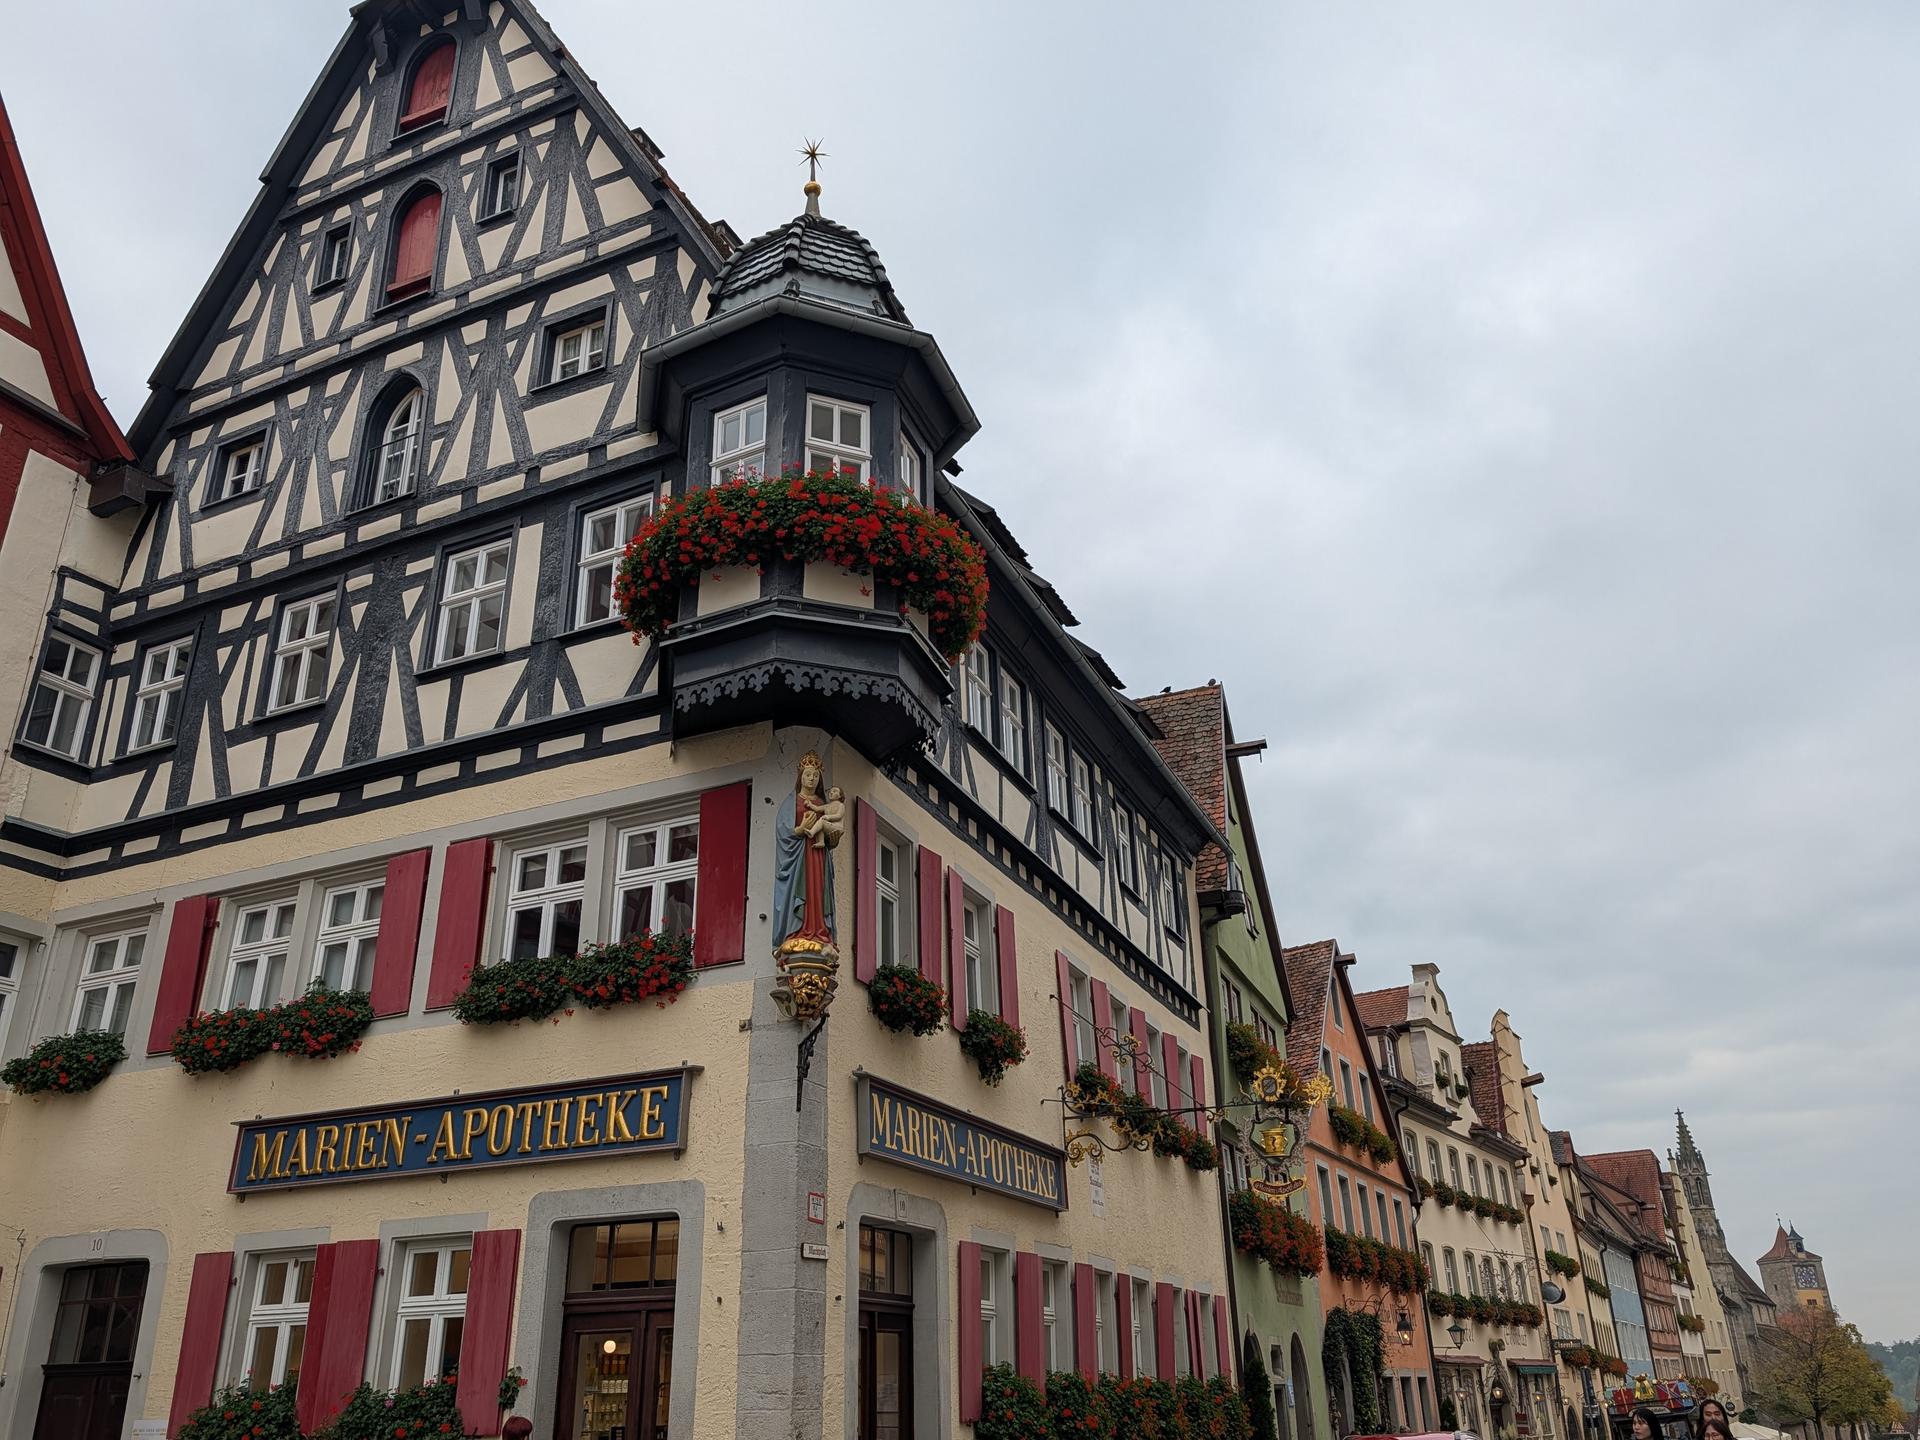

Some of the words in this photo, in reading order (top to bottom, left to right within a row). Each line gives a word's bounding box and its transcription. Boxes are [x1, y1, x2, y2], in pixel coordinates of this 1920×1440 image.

[246, 1085, 669, 1181] MARIEN-APOTHEKE
[871, 1093, 1058, 1200] MARIEN-APOTHEKE
[92, 1238, 103, 1251] 10
